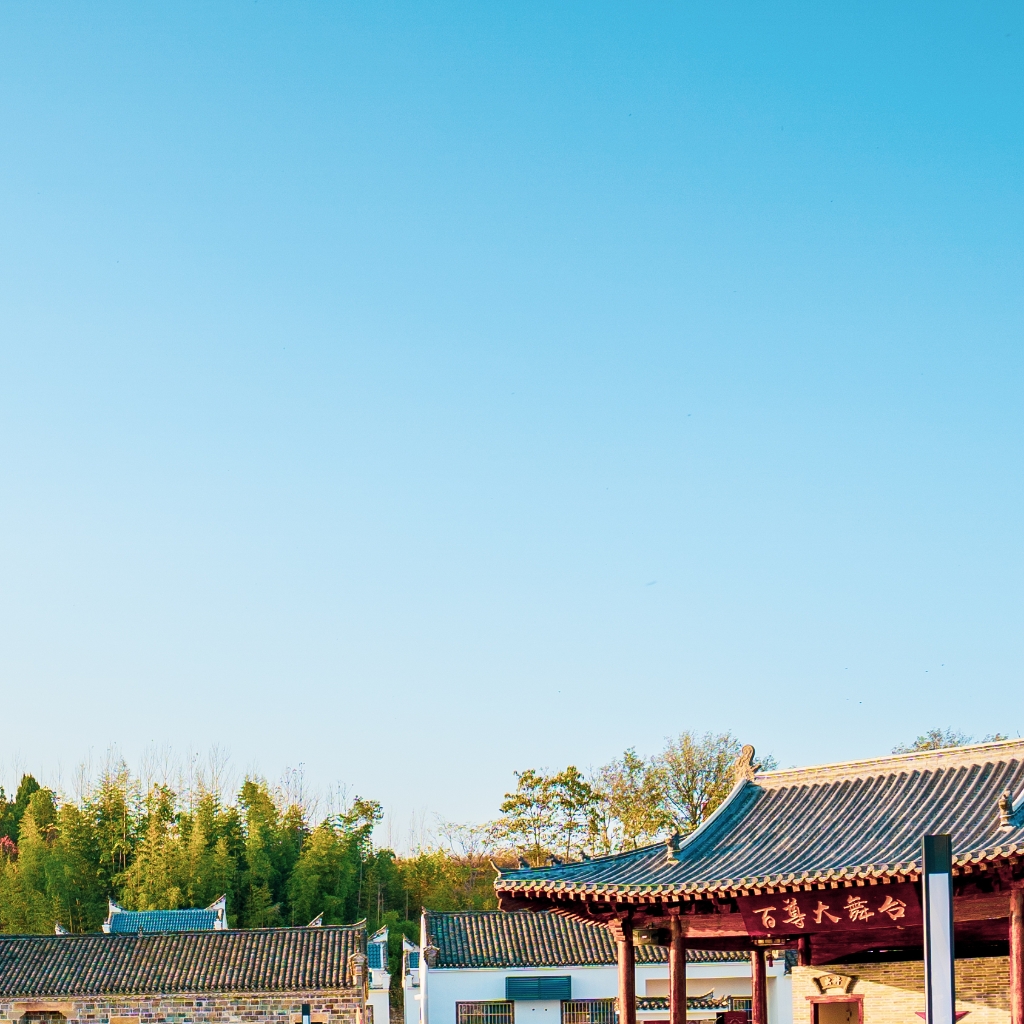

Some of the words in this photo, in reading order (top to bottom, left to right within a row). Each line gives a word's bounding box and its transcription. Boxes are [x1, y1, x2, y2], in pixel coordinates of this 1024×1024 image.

[753, 895, 906, 928] 百尊大舞台
